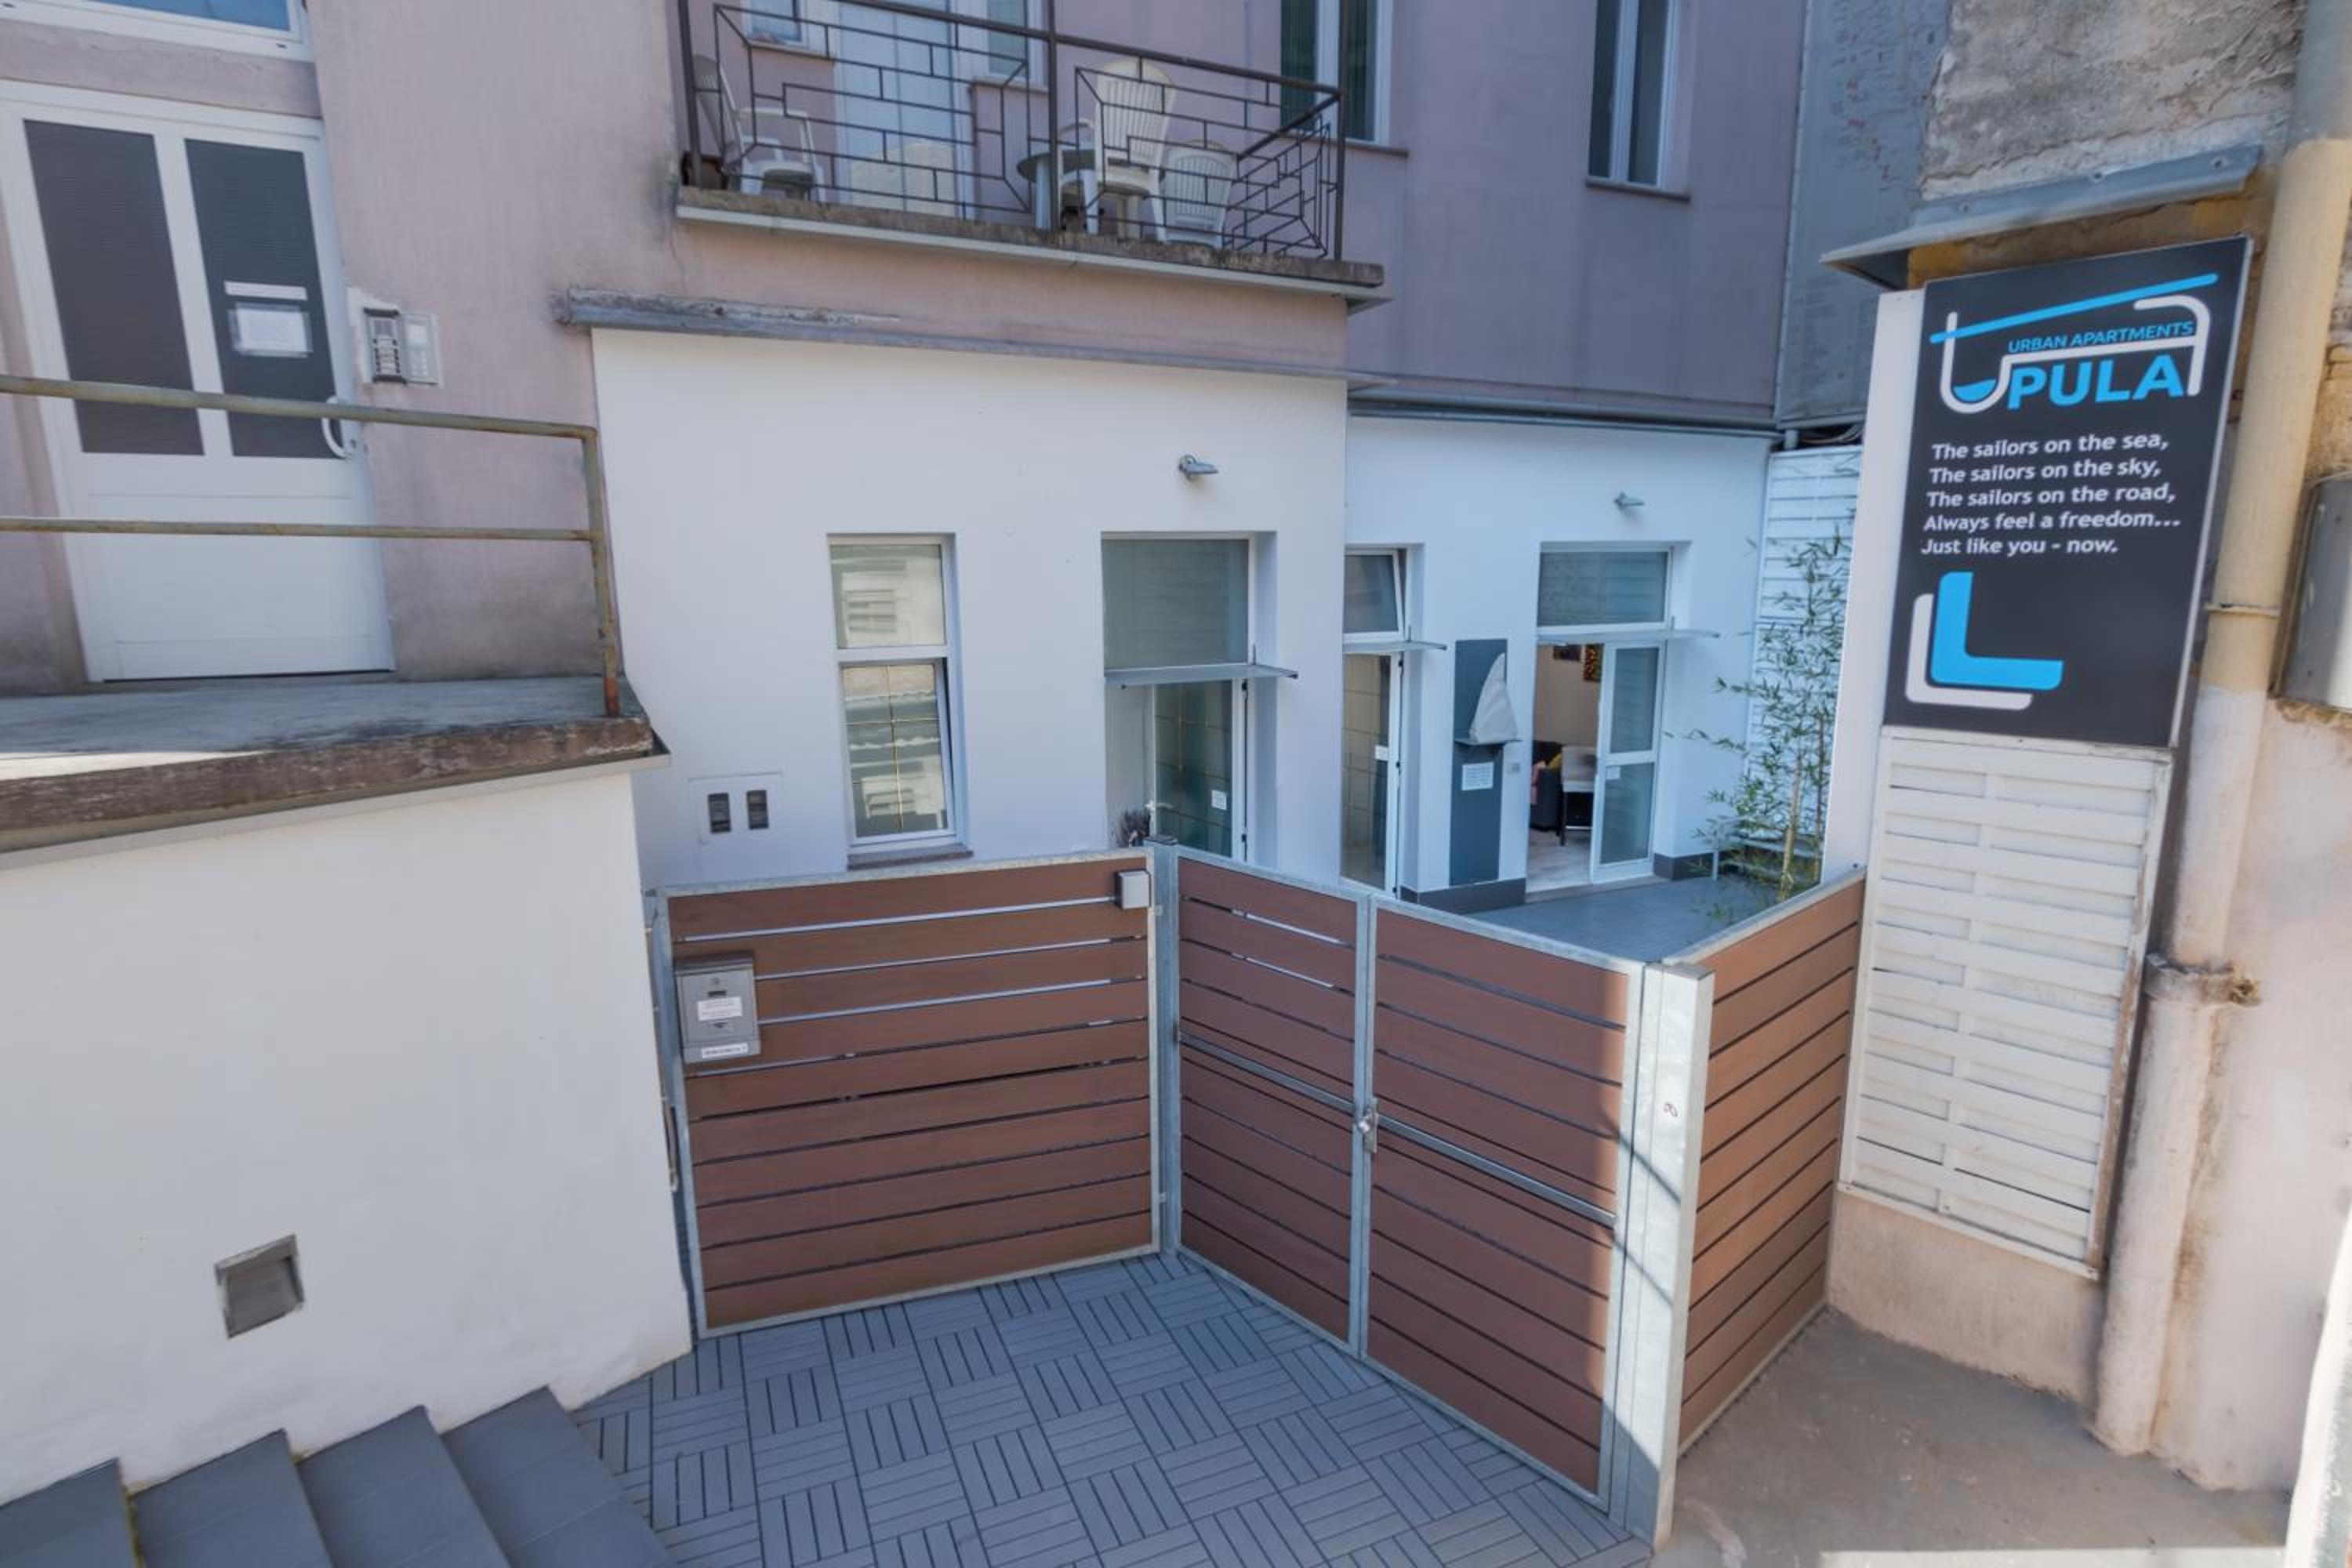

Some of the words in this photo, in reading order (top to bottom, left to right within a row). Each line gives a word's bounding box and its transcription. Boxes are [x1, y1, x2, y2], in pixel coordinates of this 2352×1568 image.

[2008, 335, 2067, 354] URBAN
[2071, 321, 2194, 347] APARTMENTS
[2007, 354, 2184, 409] PULA
[1932, 444, 1968, 460] The
[1973, 439, 2038, 458] sailors
[2044, 440, 2071, 453] on
[2078, 435, 2115, 452] the
[2122, 434, 2169, 450] sea,
[1929, 467, 1965, 484] The
[1970, 463, 2034, 482] sailors
[2042, 465, 2067, 478] on
[2074, 459, 2113, 477] the
[2118, 459, 2161, 479] sky,
[1926, 492, 1962, 507] The
[1967, 488, 2031, 506] sailors
[2038, 489, 2064, 503] on
[2071, 485, 2109, 502] the
[2115, 484, 2176, 503] road,
[1923, 514, 1990, 534] Always
[1994, 513, 2034, 529] feel
[2041, 516, 2053, 528] a
[2059, 510, 2180, 529] freedom...
[1921, 539, 1961, 554] Just
[1966, 538, 2002, 554] like
[2008, 539, 2045, 557] you
[2067, 538, 2119, 554] now.
